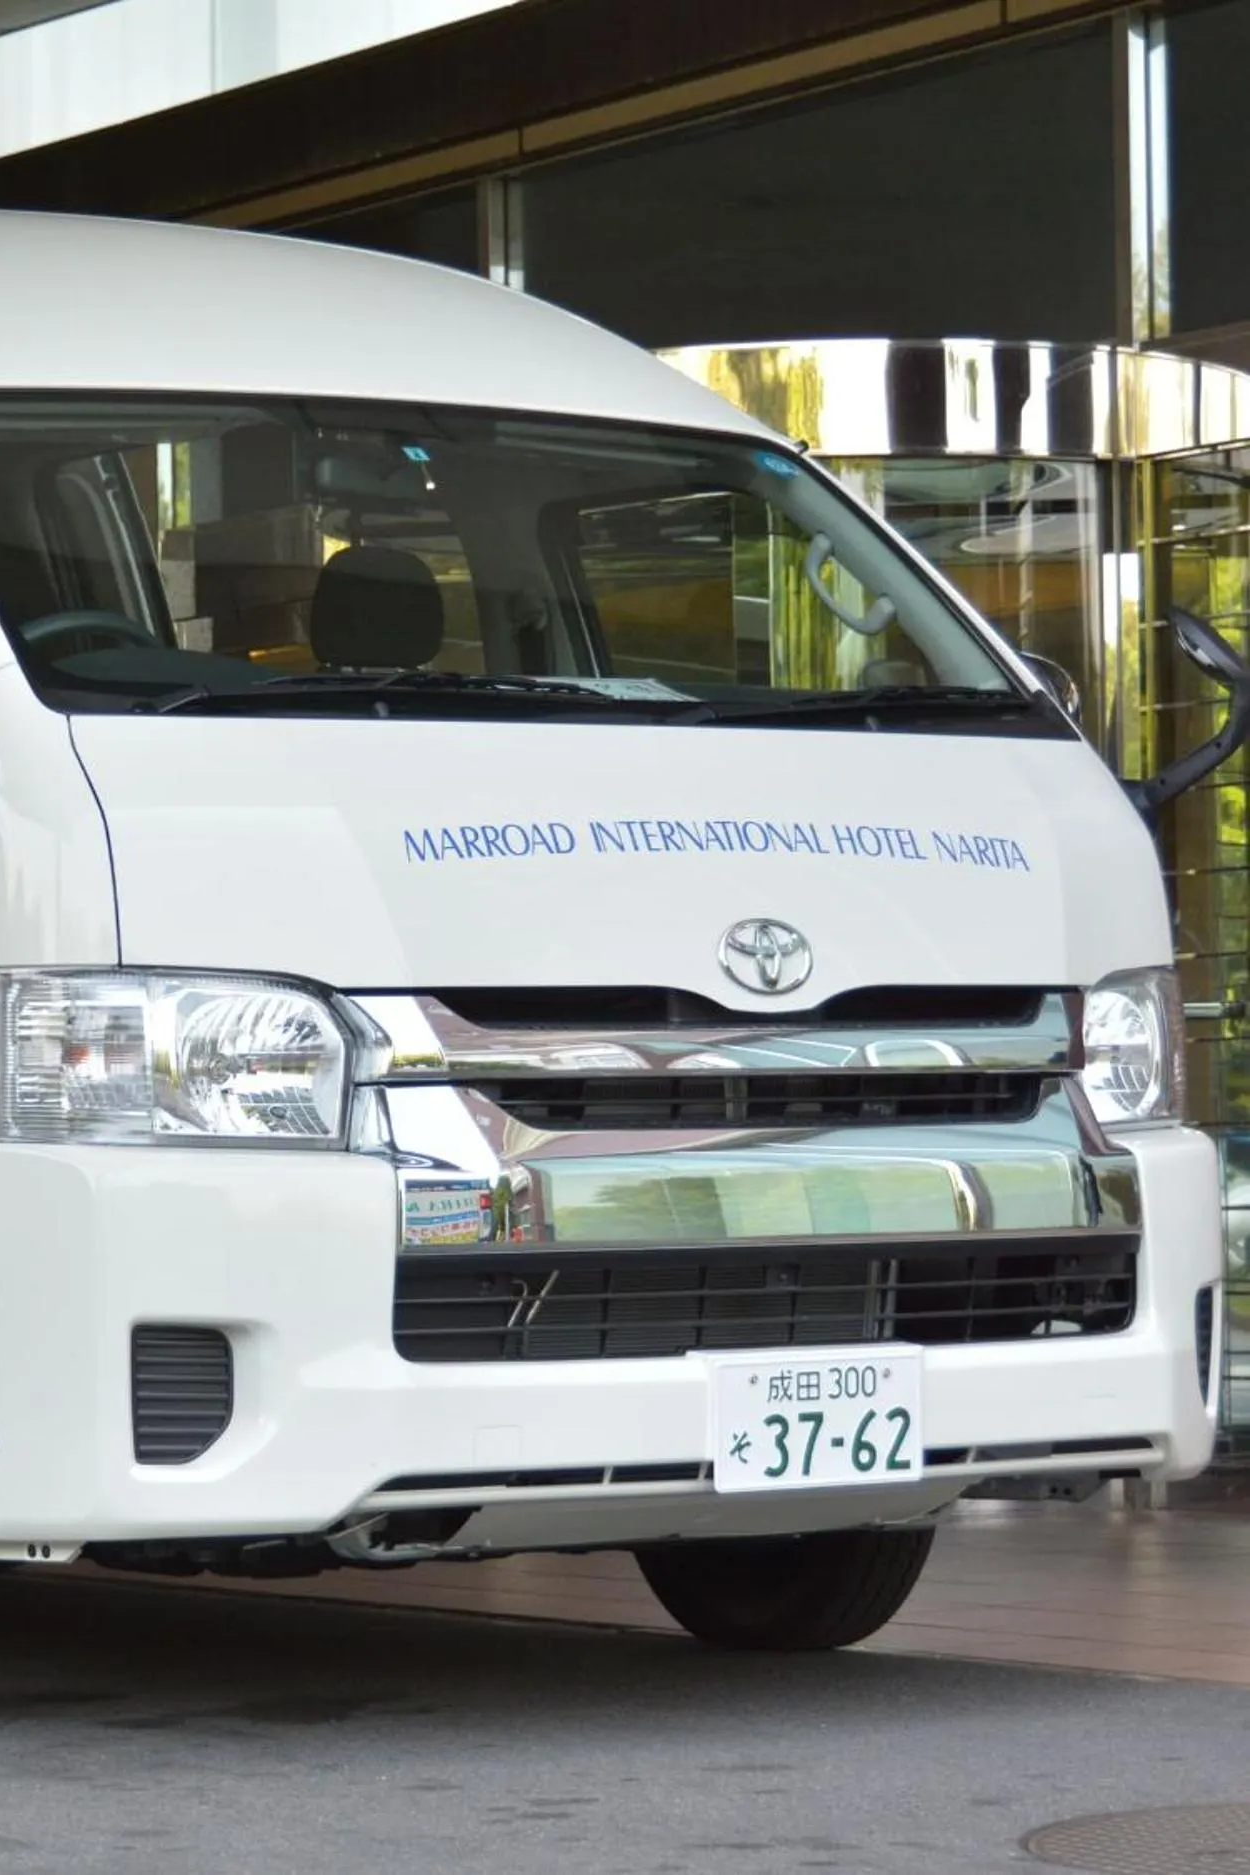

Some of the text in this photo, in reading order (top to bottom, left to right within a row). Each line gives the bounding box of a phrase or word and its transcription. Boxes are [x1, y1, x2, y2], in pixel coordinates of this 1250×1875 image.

[403, 819, 1031, 873] MARROAD INTERNATIONAL HOTEL NARITA
[767, 1364, 878, 1403] 成田 300
[729, 1405, 912, 1479] そ 37-62
